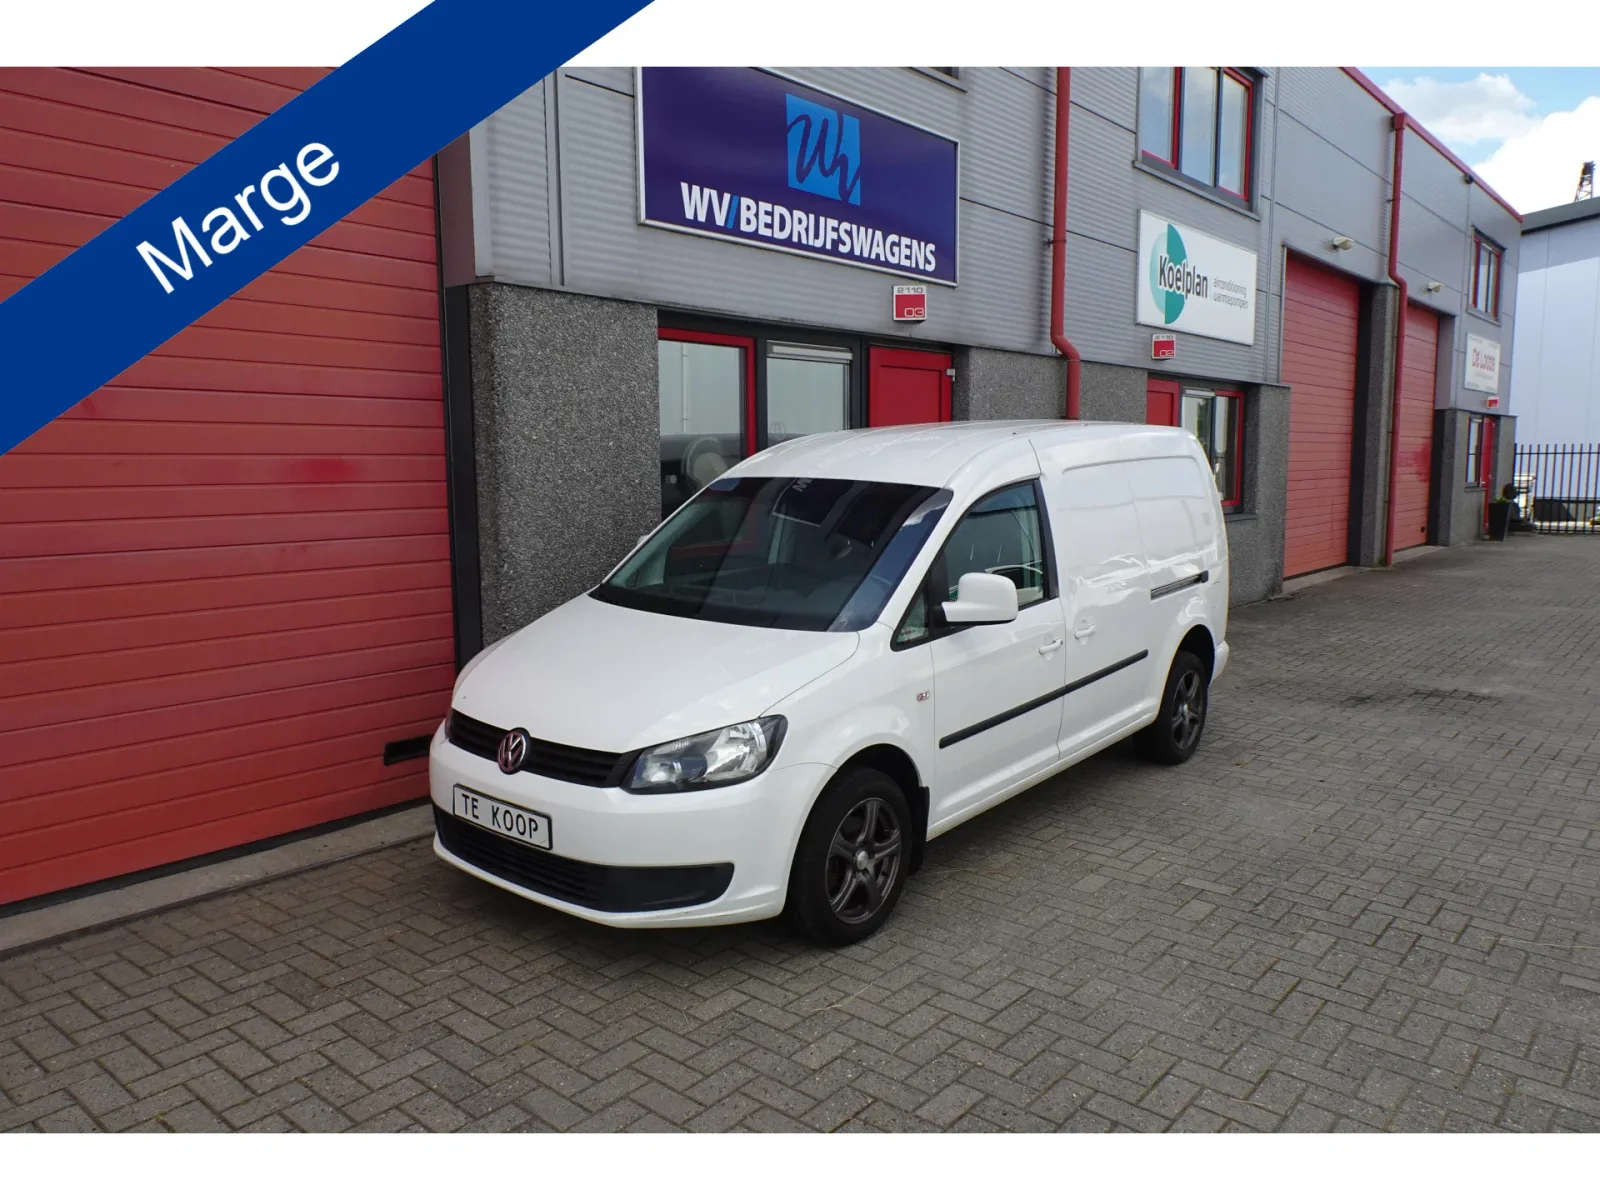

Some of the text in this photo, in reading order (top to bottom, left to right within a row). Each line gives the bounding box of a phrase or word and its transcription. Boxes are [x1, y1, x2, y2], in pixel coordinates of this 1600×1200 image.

[1159, 255, 1208, 299] Koelplan
[904, 307, 924, 317] 03
[1160, 349, 1174, 357] 02
[461, 793, 539, 839] TE KOOP
